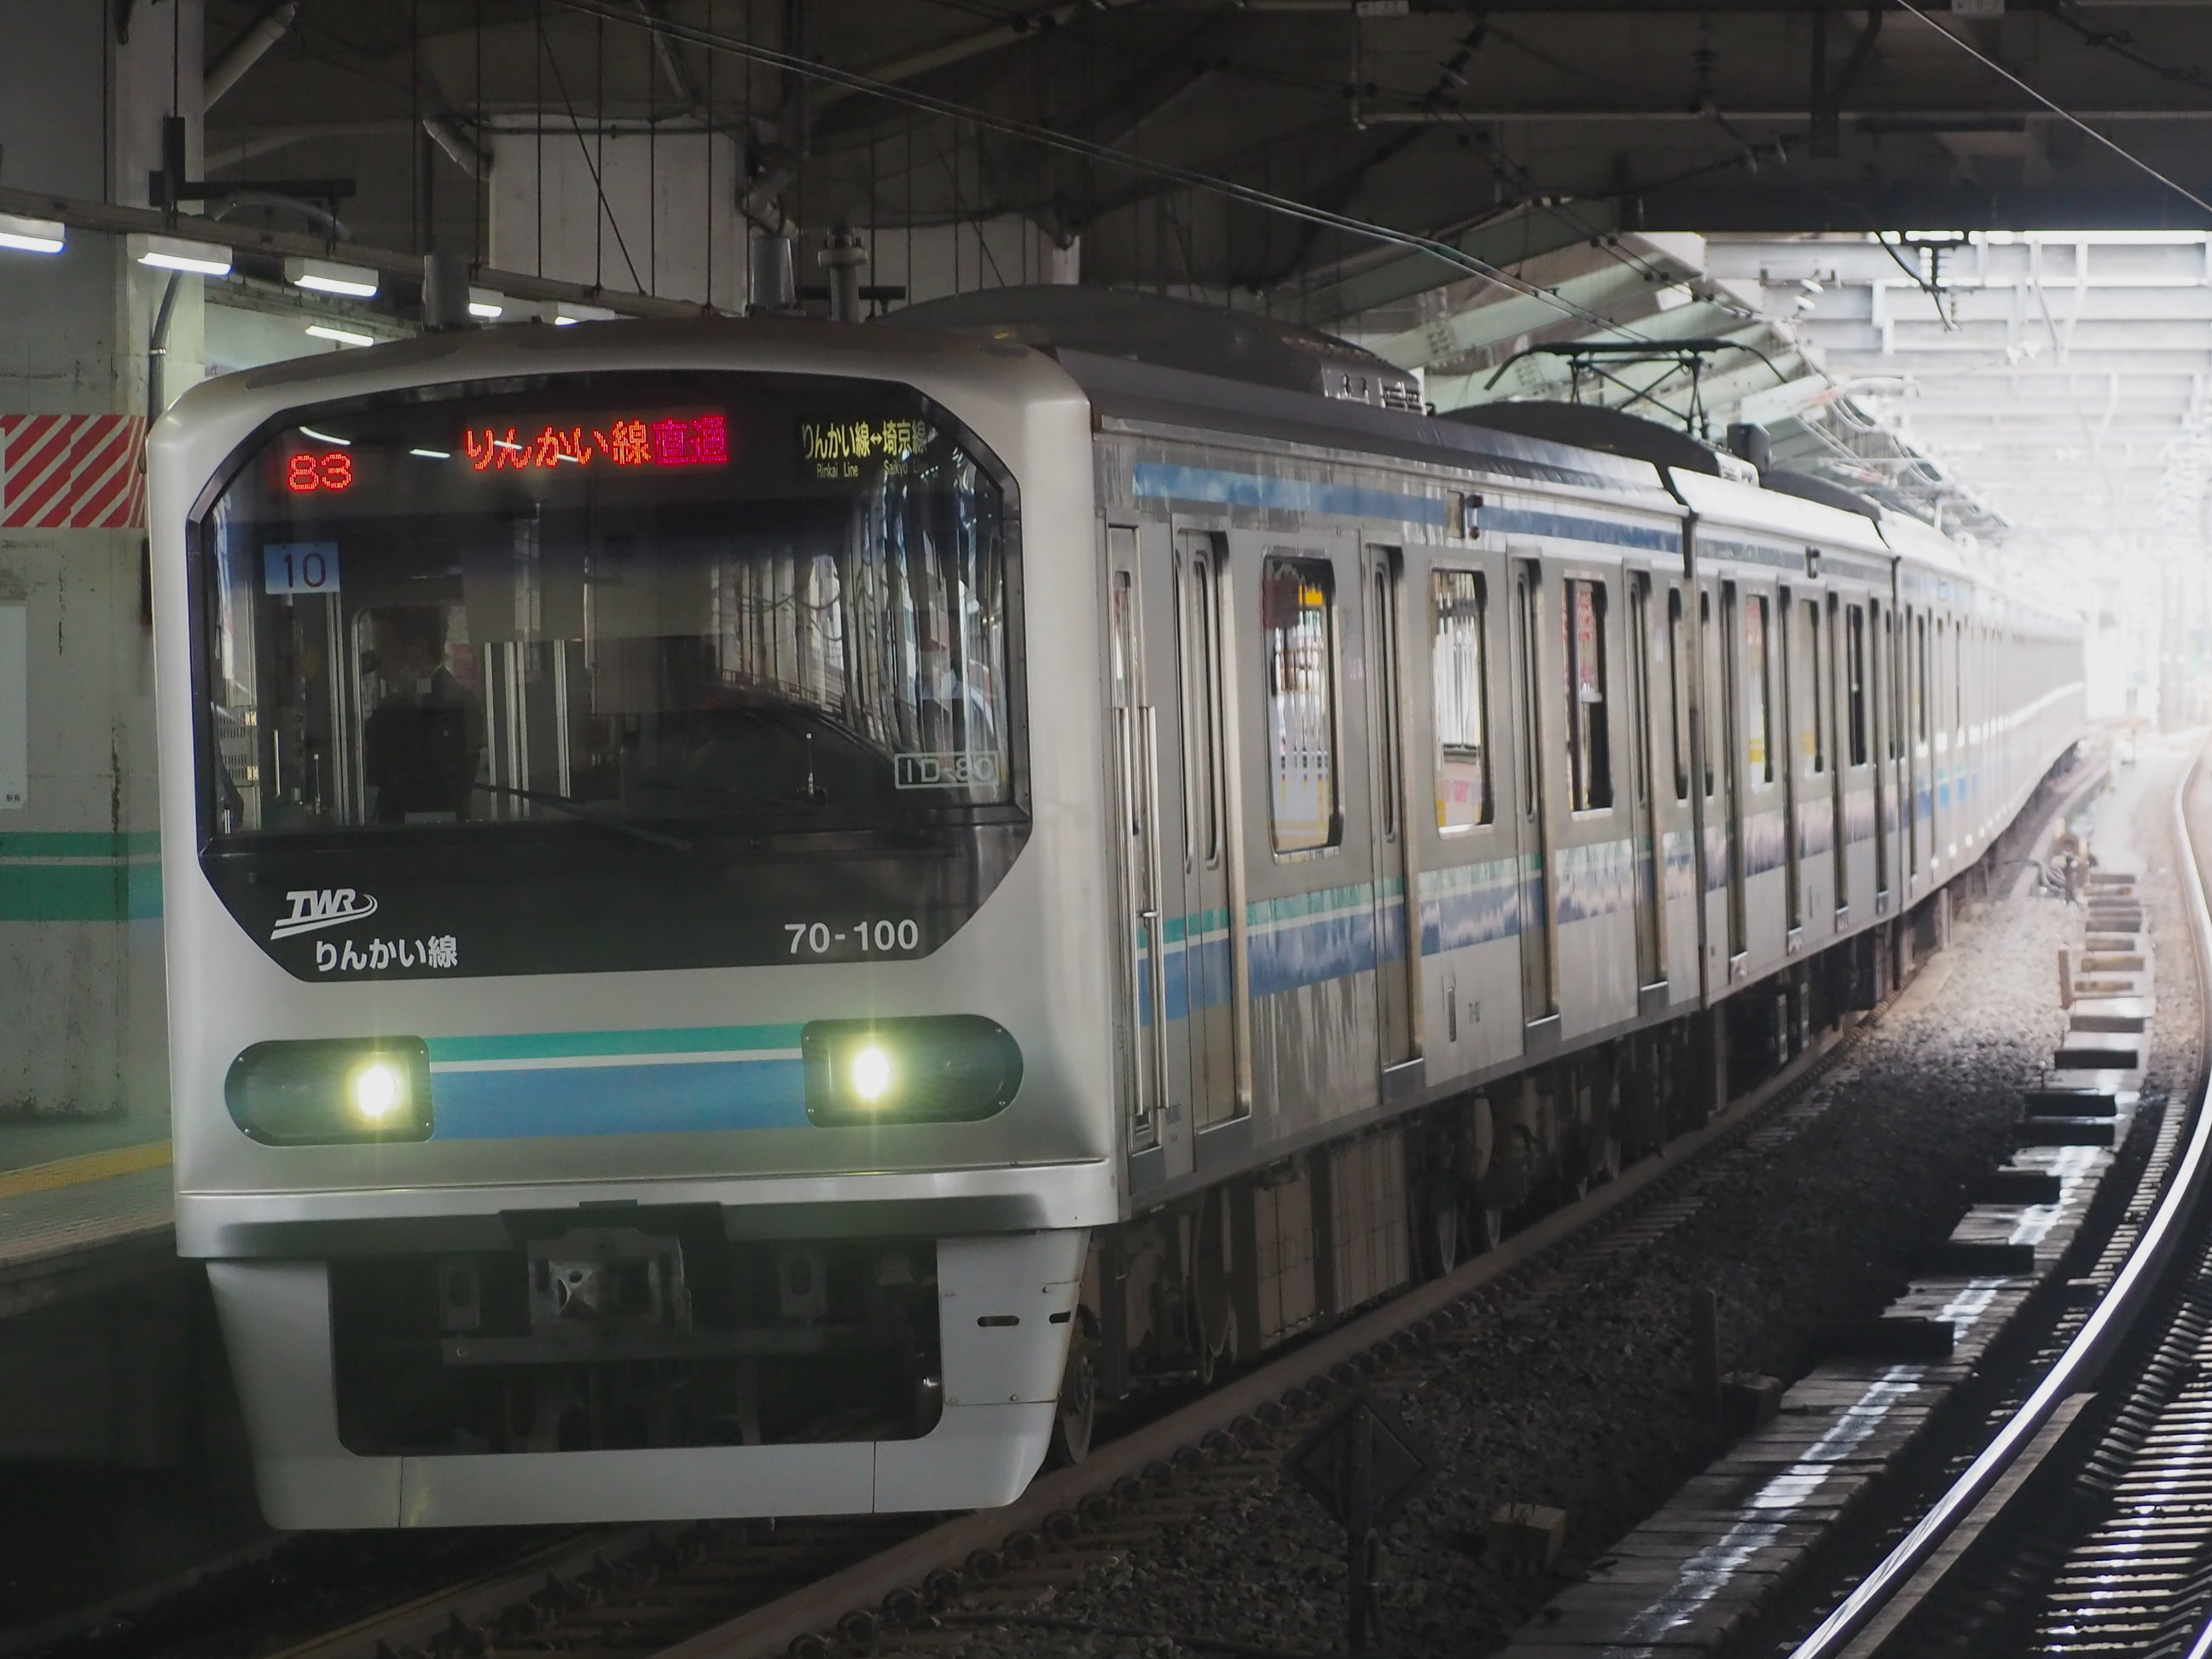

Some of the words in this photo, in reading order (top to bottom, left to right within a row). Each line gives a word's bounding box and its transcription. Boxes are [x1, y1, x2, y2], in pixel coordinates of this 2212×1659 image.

[802, 421, 870, 460] りんかい線
[290, 453, 352, 490] 83
[816, 463, 839, 478] Rinkai
[843, 461, 859, 478] Line
[884, 459, 909, 478] Saikyo
[284, 553, 326, 589] 10
[277, 888, 359, 926] TWR
[316, 935, 459, 972] りんかい線
[784, 919, 919, 954] 70-100
